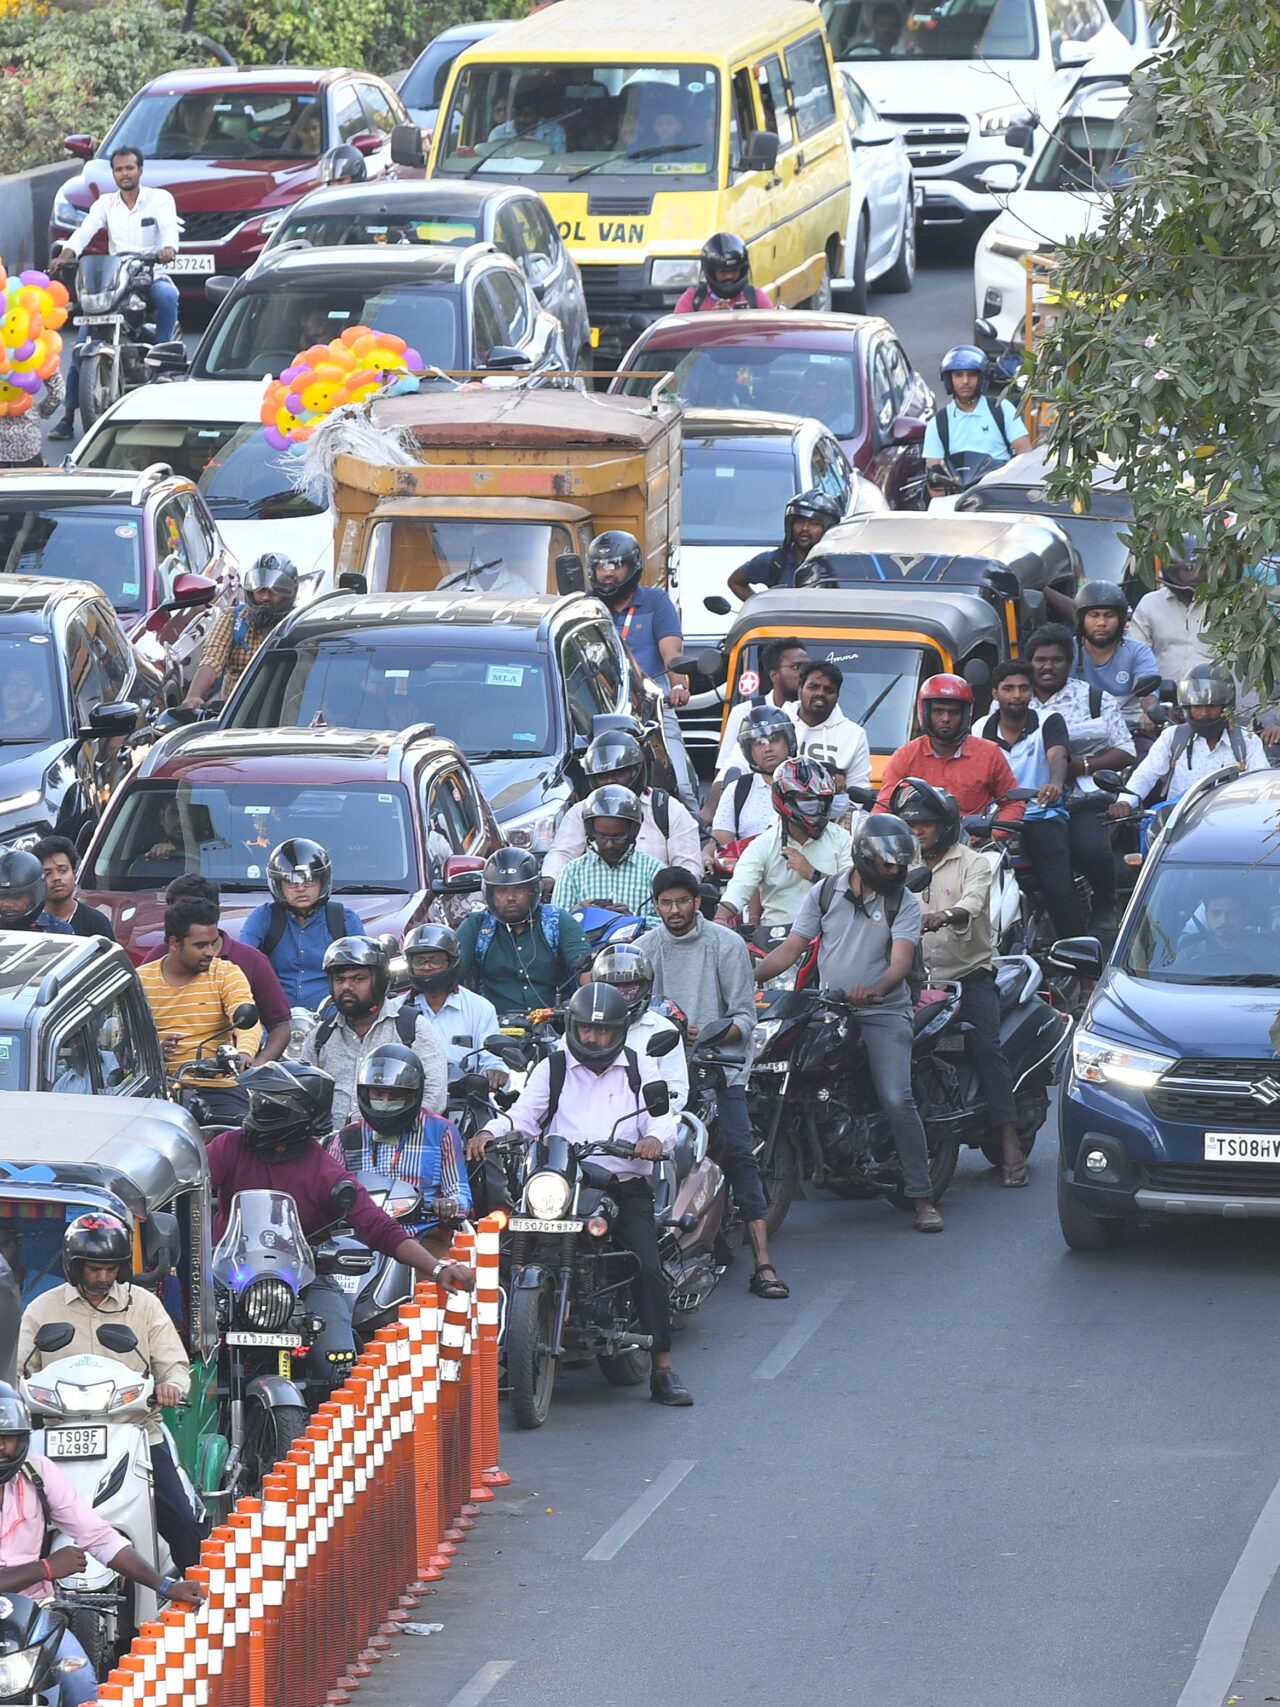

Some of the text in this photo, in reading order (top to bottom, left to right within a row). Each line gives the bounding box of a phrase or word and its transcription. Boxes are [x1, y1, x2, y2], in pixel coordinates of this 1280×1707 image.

[599, 222, 644, 244] VAN
[424, 472, 470, 490] GOODS
[825, 651, 859, 665] Amma
[492, 674, 518, 683] MLA
[58, 1431, 98, 1445] TS09F
[57, 1442, 98, 1455] 04997
